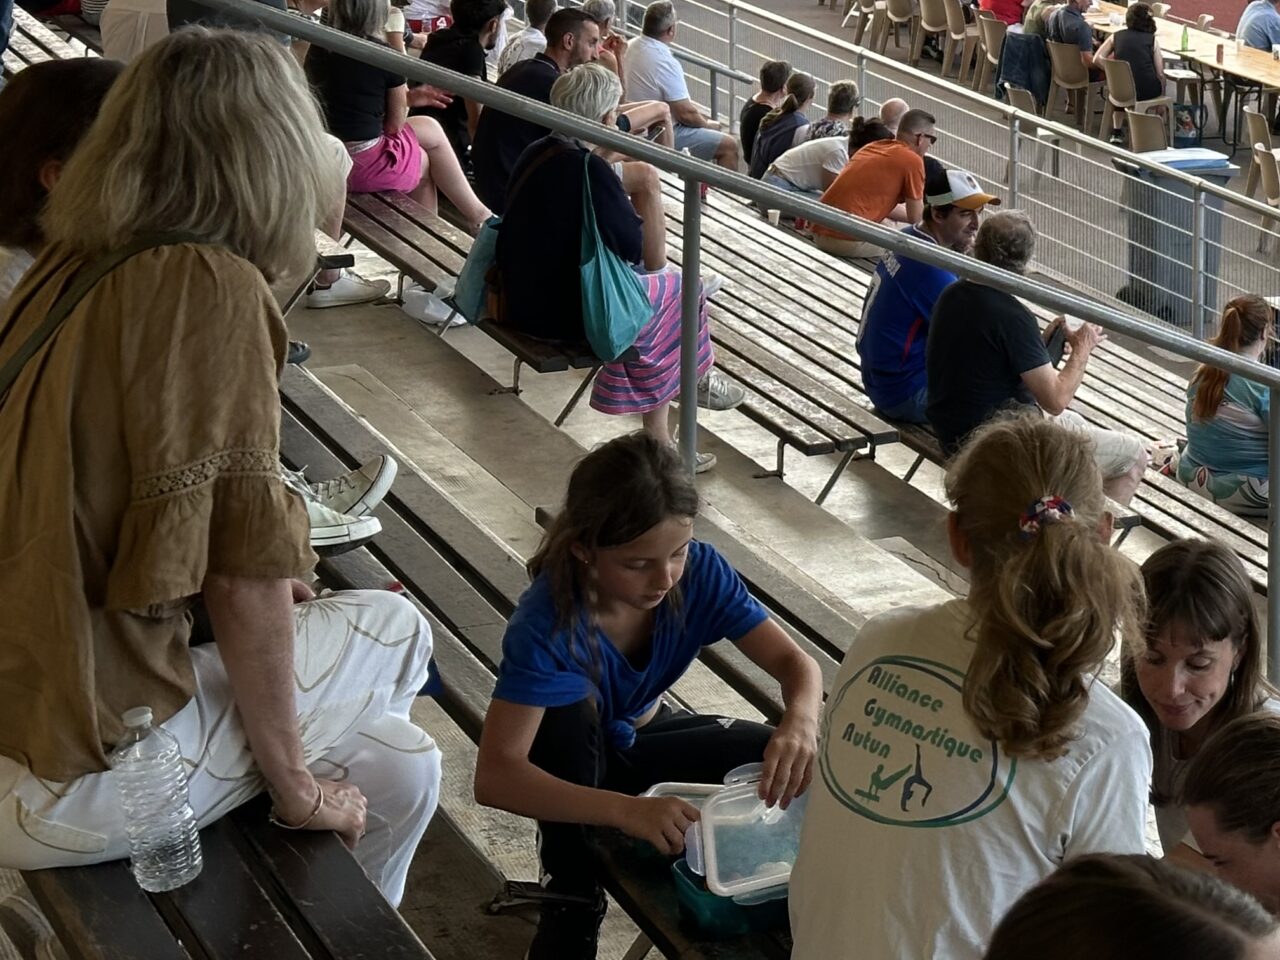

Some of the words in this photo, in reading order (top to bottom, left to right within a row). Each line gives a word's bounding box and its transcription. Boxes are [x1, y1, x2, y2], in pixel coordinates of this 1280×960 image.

[867, 666, 944, 713] Alliance
[841, 723, 891, 759] Autun
[863, 697, 983, 764] Gymnastique
